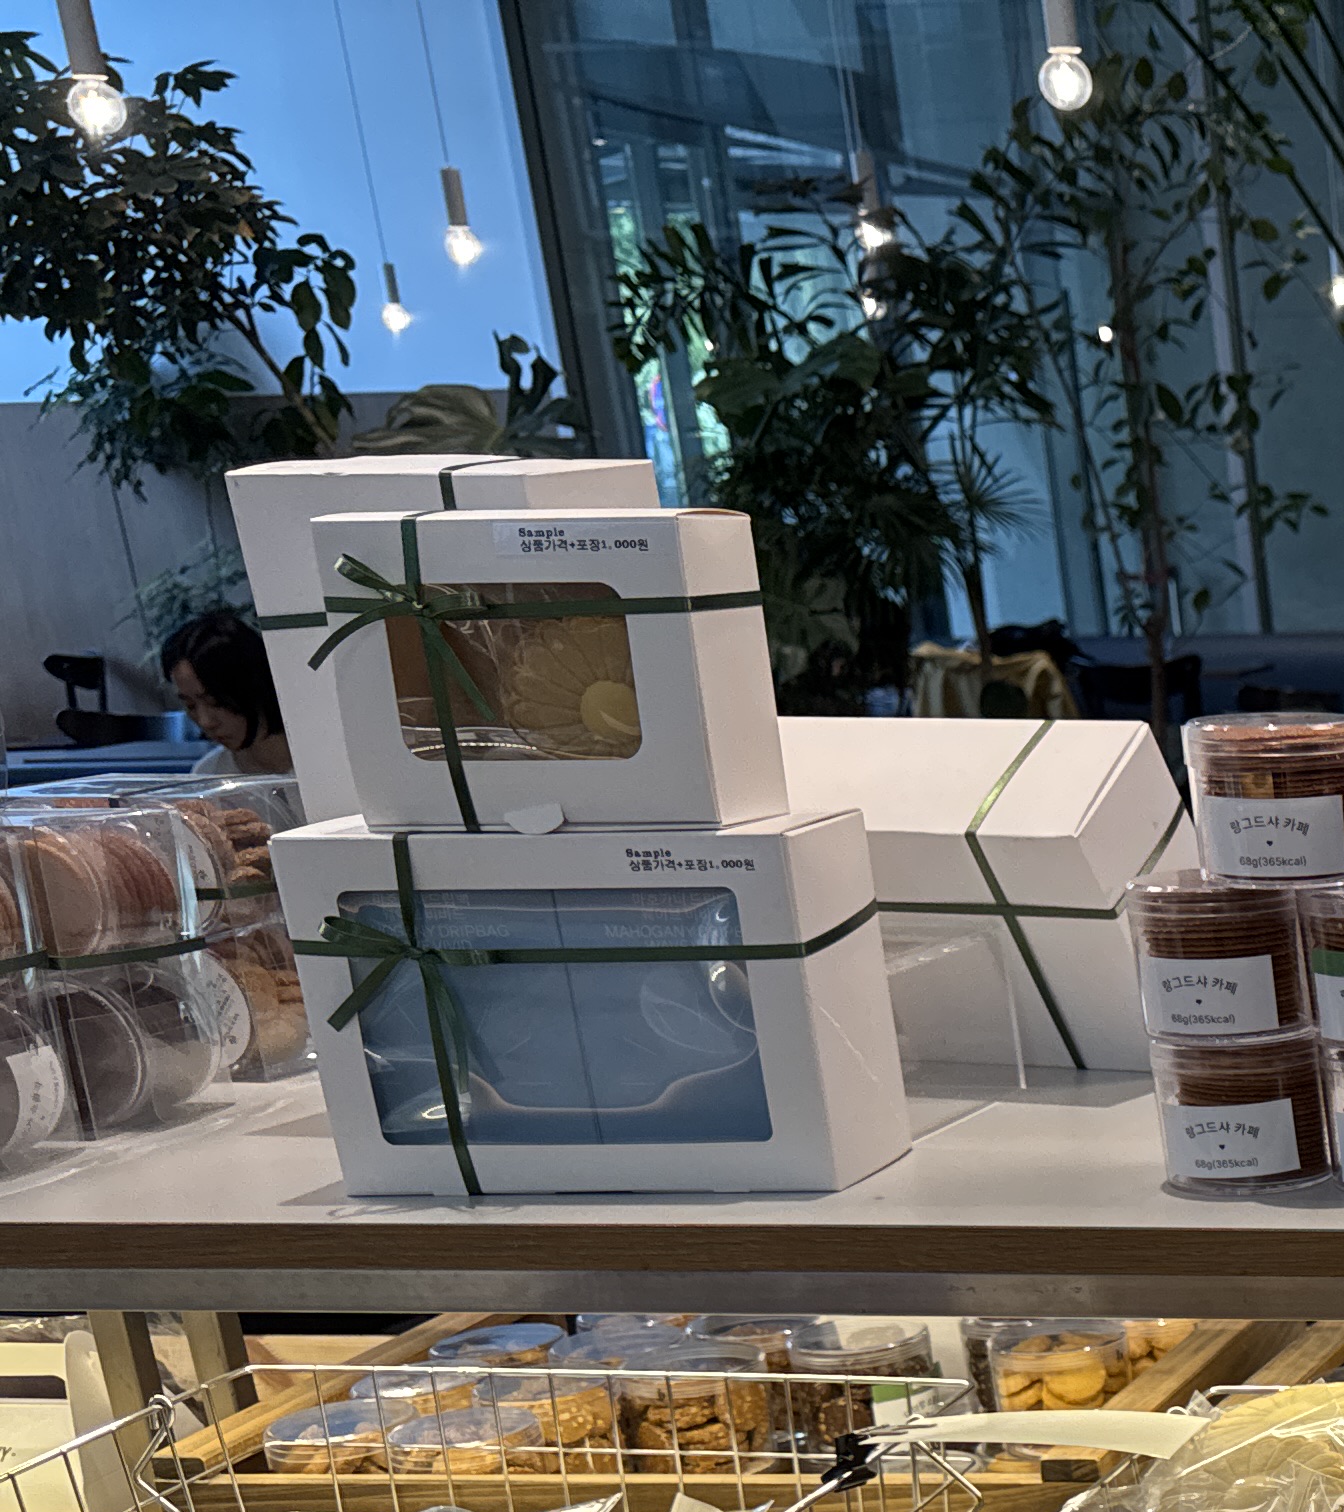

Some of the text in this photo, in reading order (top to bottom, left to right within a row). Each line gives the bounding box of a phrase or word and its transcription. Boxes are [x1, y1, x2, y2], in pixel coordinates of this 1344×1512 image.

[518, 527, 565, 538] Sample
[1230, 815, 1309, 836] 랑그드샤 카페
[625, 848, 672, 859] Sample
[1162, 976, 1238, 995] 랑그드샤 카페
[1185, 1121, 1260, 1139] 랑그드샤 카페
